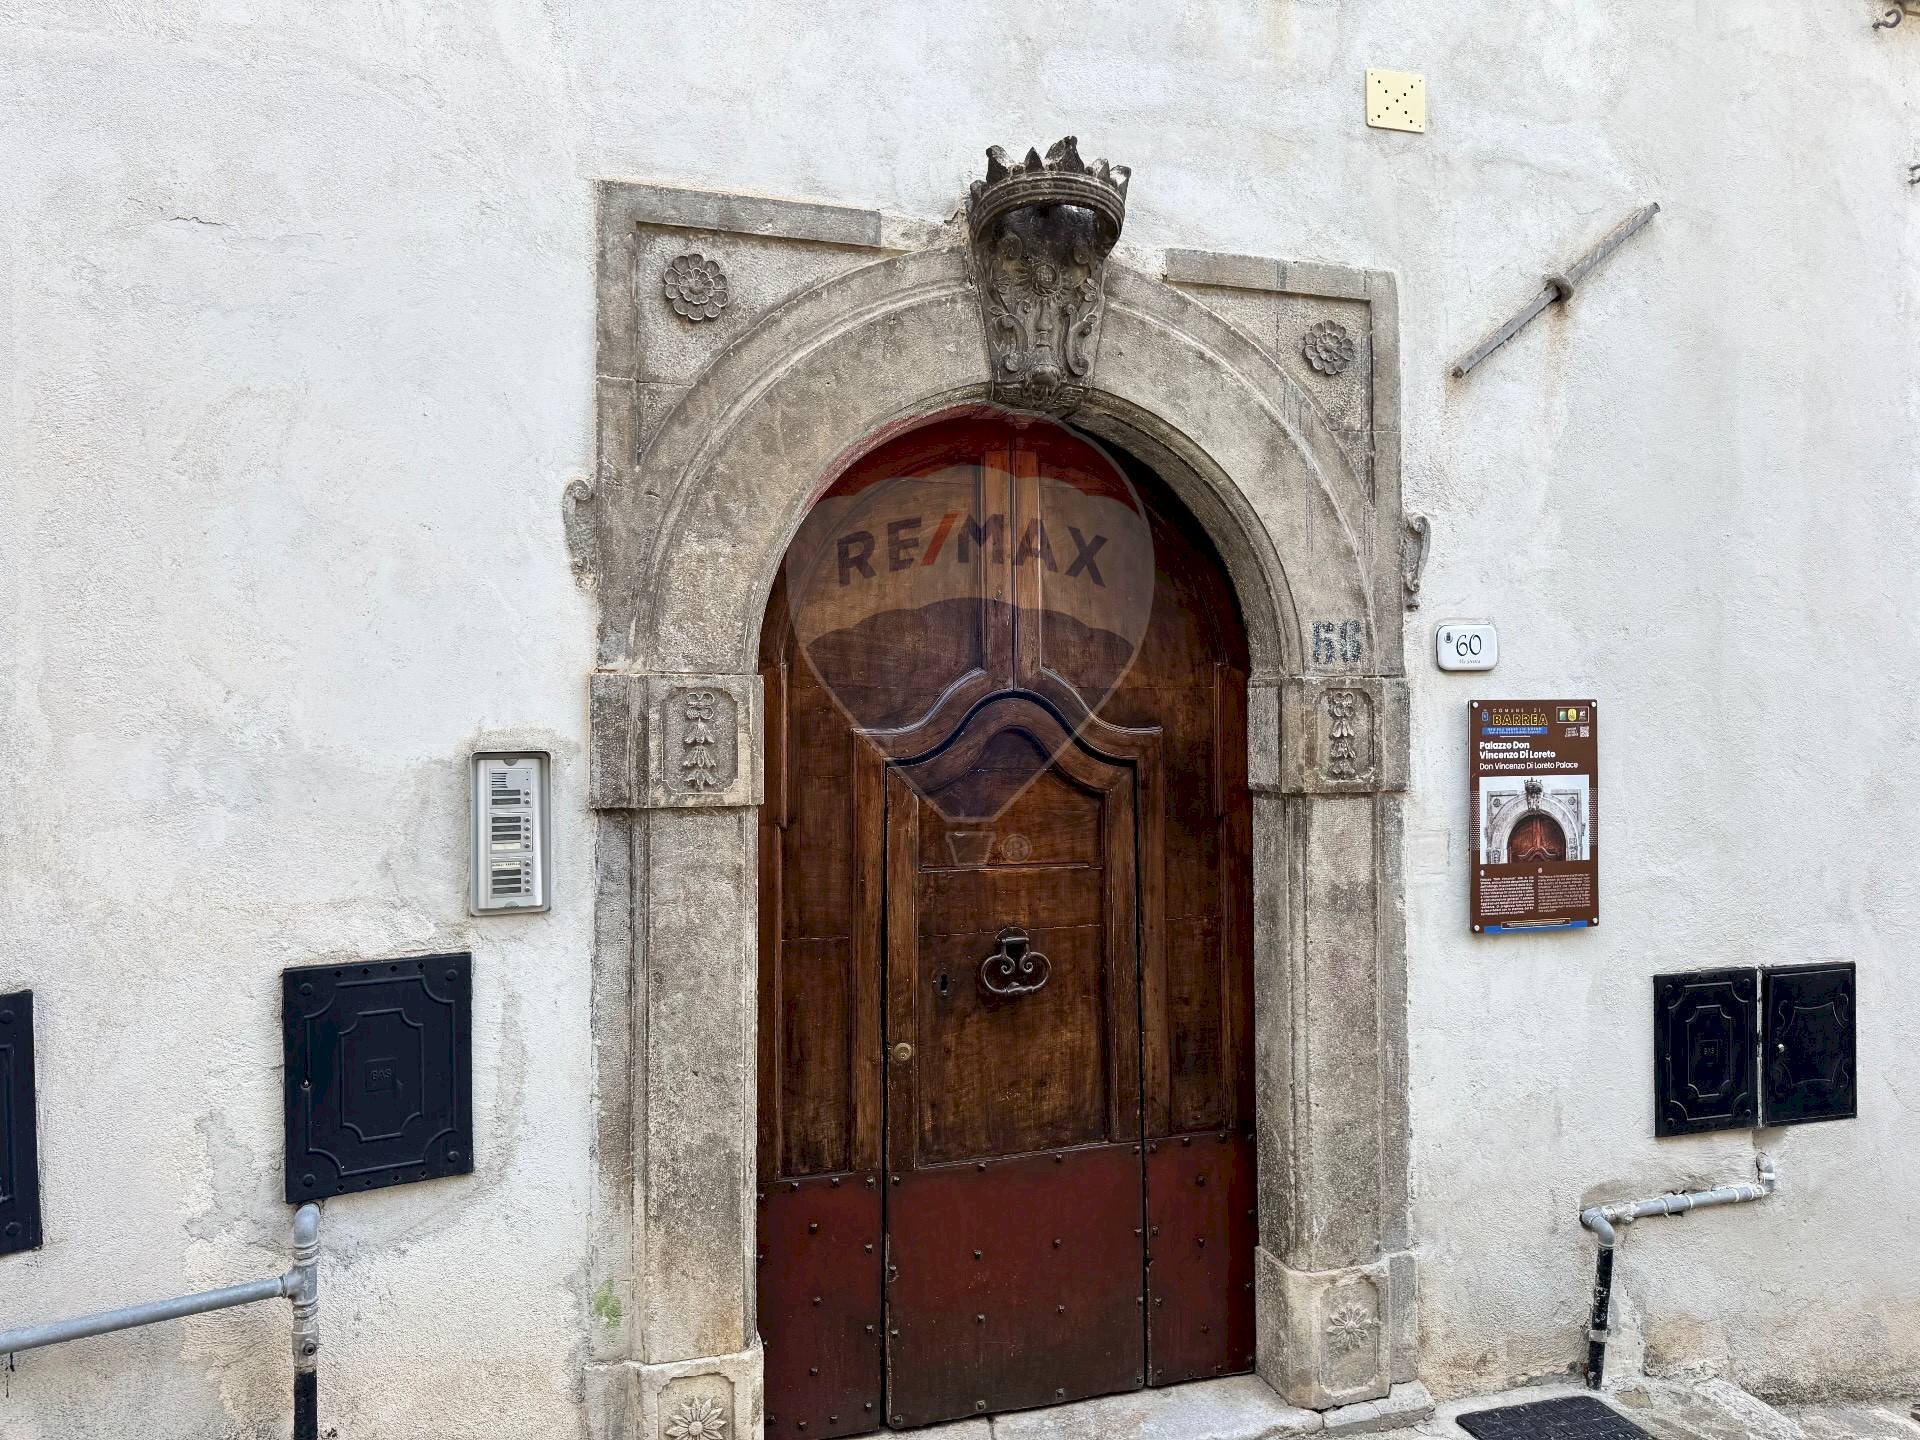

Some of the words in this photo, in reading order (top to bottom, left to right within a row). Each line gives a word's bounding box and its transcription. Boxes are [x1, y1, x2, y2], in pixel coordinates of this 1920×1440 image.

[1456, 634, 1482, 657] 60
[1492, 713, 1549, 726] BARREA
[1479, 741, 1512, 750] Palazzo
[1513, 741, 1530, 749] Don
[1479, 750, 1519, 760] Vincenzo
[1520, 750, 1529, 759] Di
[1530, 750, 1556, 759] Loreto
[1479, 762, 1494, 771] Don
[1494, 762, 1526, 770] Vincenzo
[1526, 762, 1534, 770] Di
[1534, 761, 1555, 769] Loreto
[1555, 761, 1579, 769] Palace
